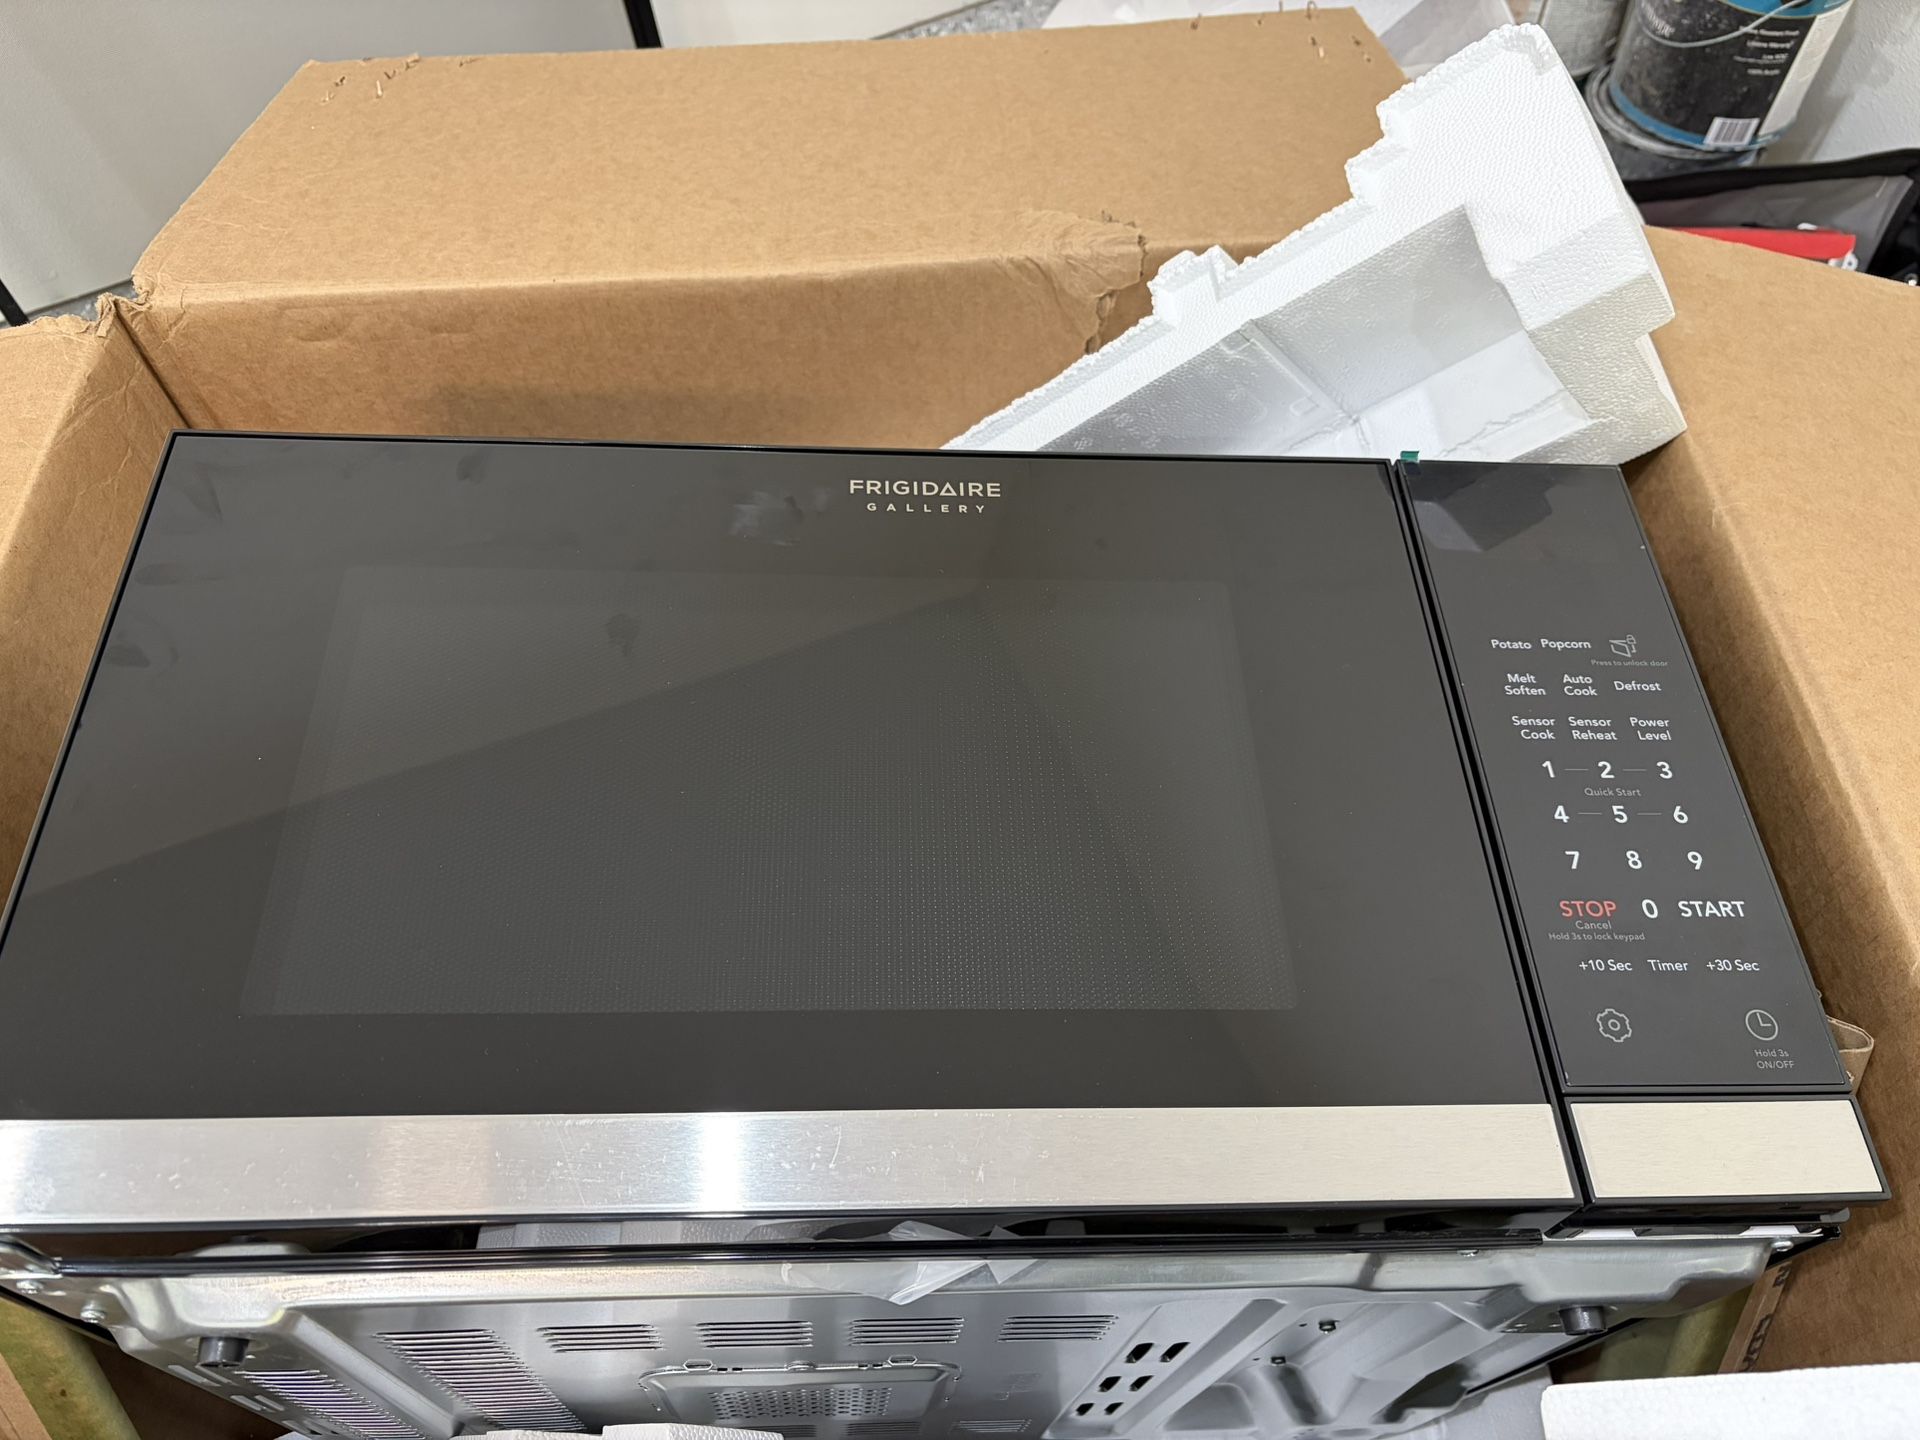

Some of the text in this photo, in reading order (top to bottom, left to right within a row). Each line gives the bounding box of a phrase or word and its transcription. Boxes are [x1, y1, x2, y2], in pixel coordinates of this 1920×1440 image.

[849, 479, 1001, 498] FRIGIDAIRE
[866, 502, 985, 514] GALLERY
[1490, 638, 1533, 650] Potato
[1540, 638, 1592, 652] Popcorn
[1591, 659, 1612, 667] Press
[1623, 659, 1648, 667] unlock
[1506, 672, 1537, 684] Melt
[1562, 673, 1593, 684] Auto
[1504, 684, 1547, 696] Soften
[1563, 685, 1598, 696] Cook
[1613, 680, 1662, 692] Defrost
[1511, 715, 1556, 727] Sensor
[1567, 716, 1612, 727] Sensor
[1629, 716, 1670, 728] Power
[1520, 728, 1556, 740] Cook
[1571, 729, 1618, 741] Reheat
[1636, 729, 1672, 741] Level
[1541, 760, 1673, 780] 1 2 3
[1584, 787, 1641, 797] Quick Start
[1553, 805, 1689, 824] 4 5 6
[1564, 850, 1703, 871] 7 8 9
[1559, 900, 1617, 918] STOP
[1641, 898, 1659, 919] 0
[1677, 900, 1745, 918] START
[1575, 919, 1611, 930] Cancel
[1549, 931, 1645, 943] Hold 3s to lock keypad
[1578, 958, 1633, 972] +10 Sec
[1646, 959, 1689, 972] Timer
[1706, 958, 1760, 972] +30 Sec
[1754, 1048, 1789, 1058] Hold 3s
[1757, 1060, 1794, 1069] ON/OFF
